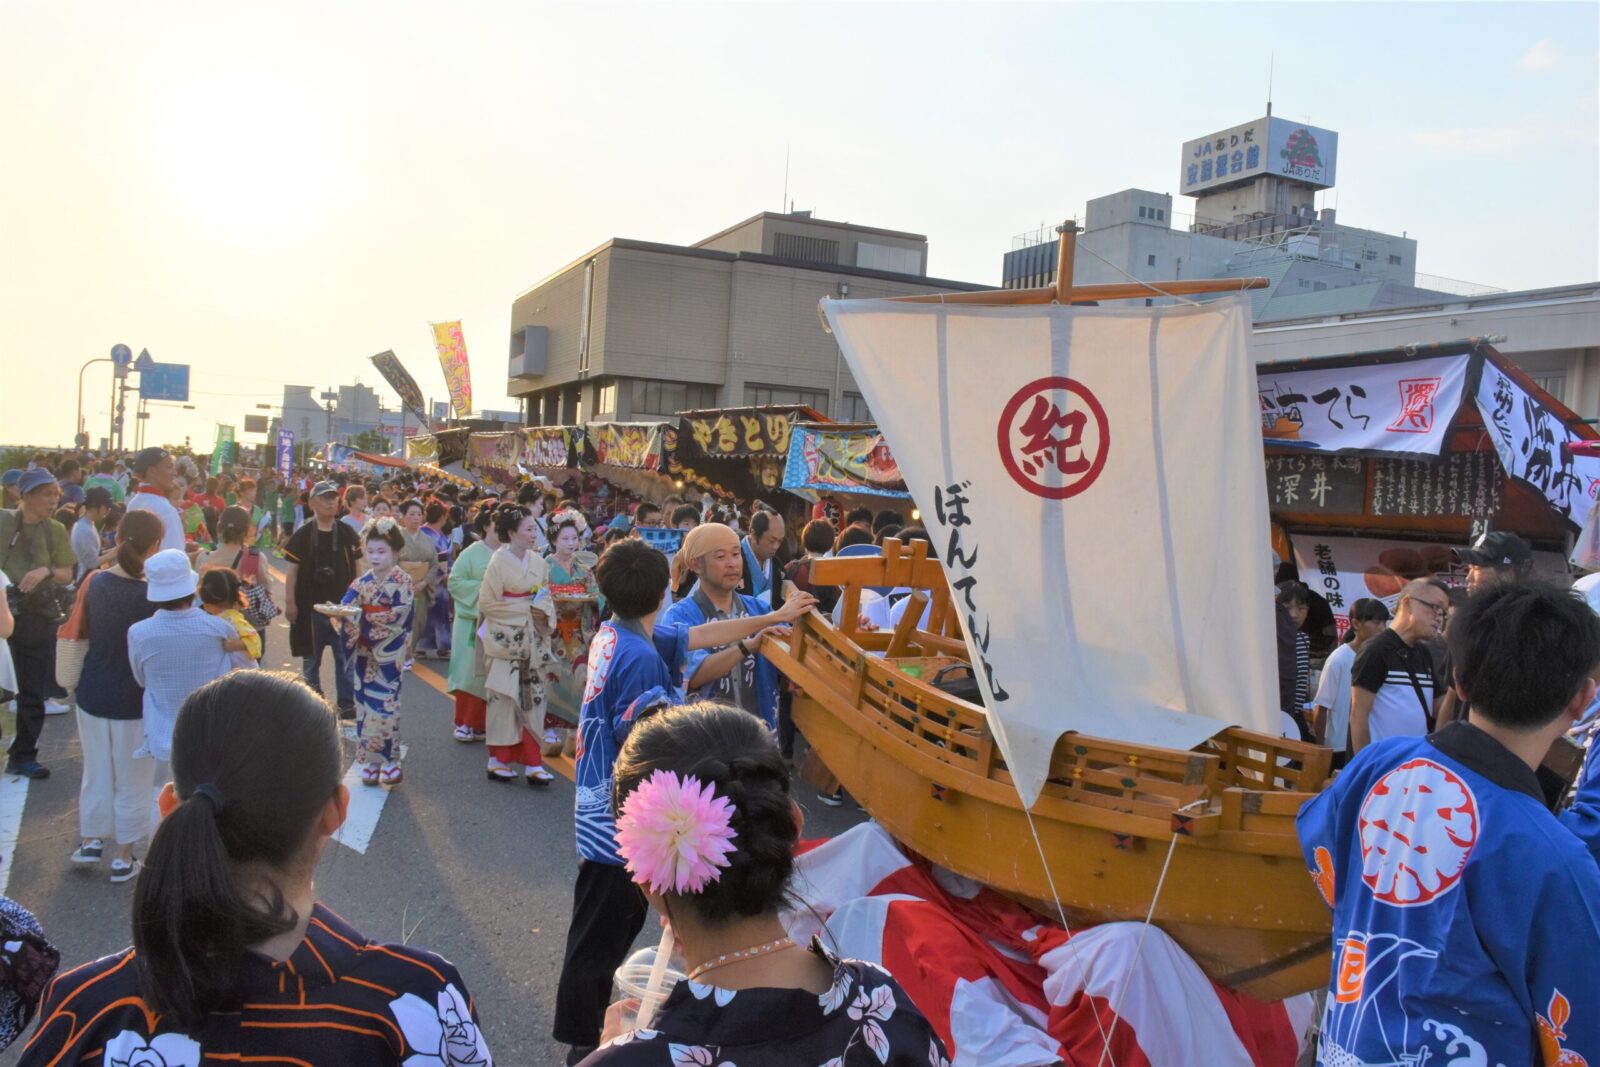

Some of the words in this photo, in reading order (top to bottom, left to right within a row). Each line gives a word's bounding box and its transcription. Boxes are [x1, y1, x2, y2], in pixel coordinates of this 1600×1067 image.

[1194, 128, 1254, 158] JAありだ
[1282, 161, 1321, 181] JAありだ
[1259, 384, 1371, 431] すてら
[691, 414, 789, 454] やきとり
[1019, 394, 1091, 476] 紀
[1276, 472, 1332, 507] 深井
[1314, 543, 1345, 608] 老舗の味
